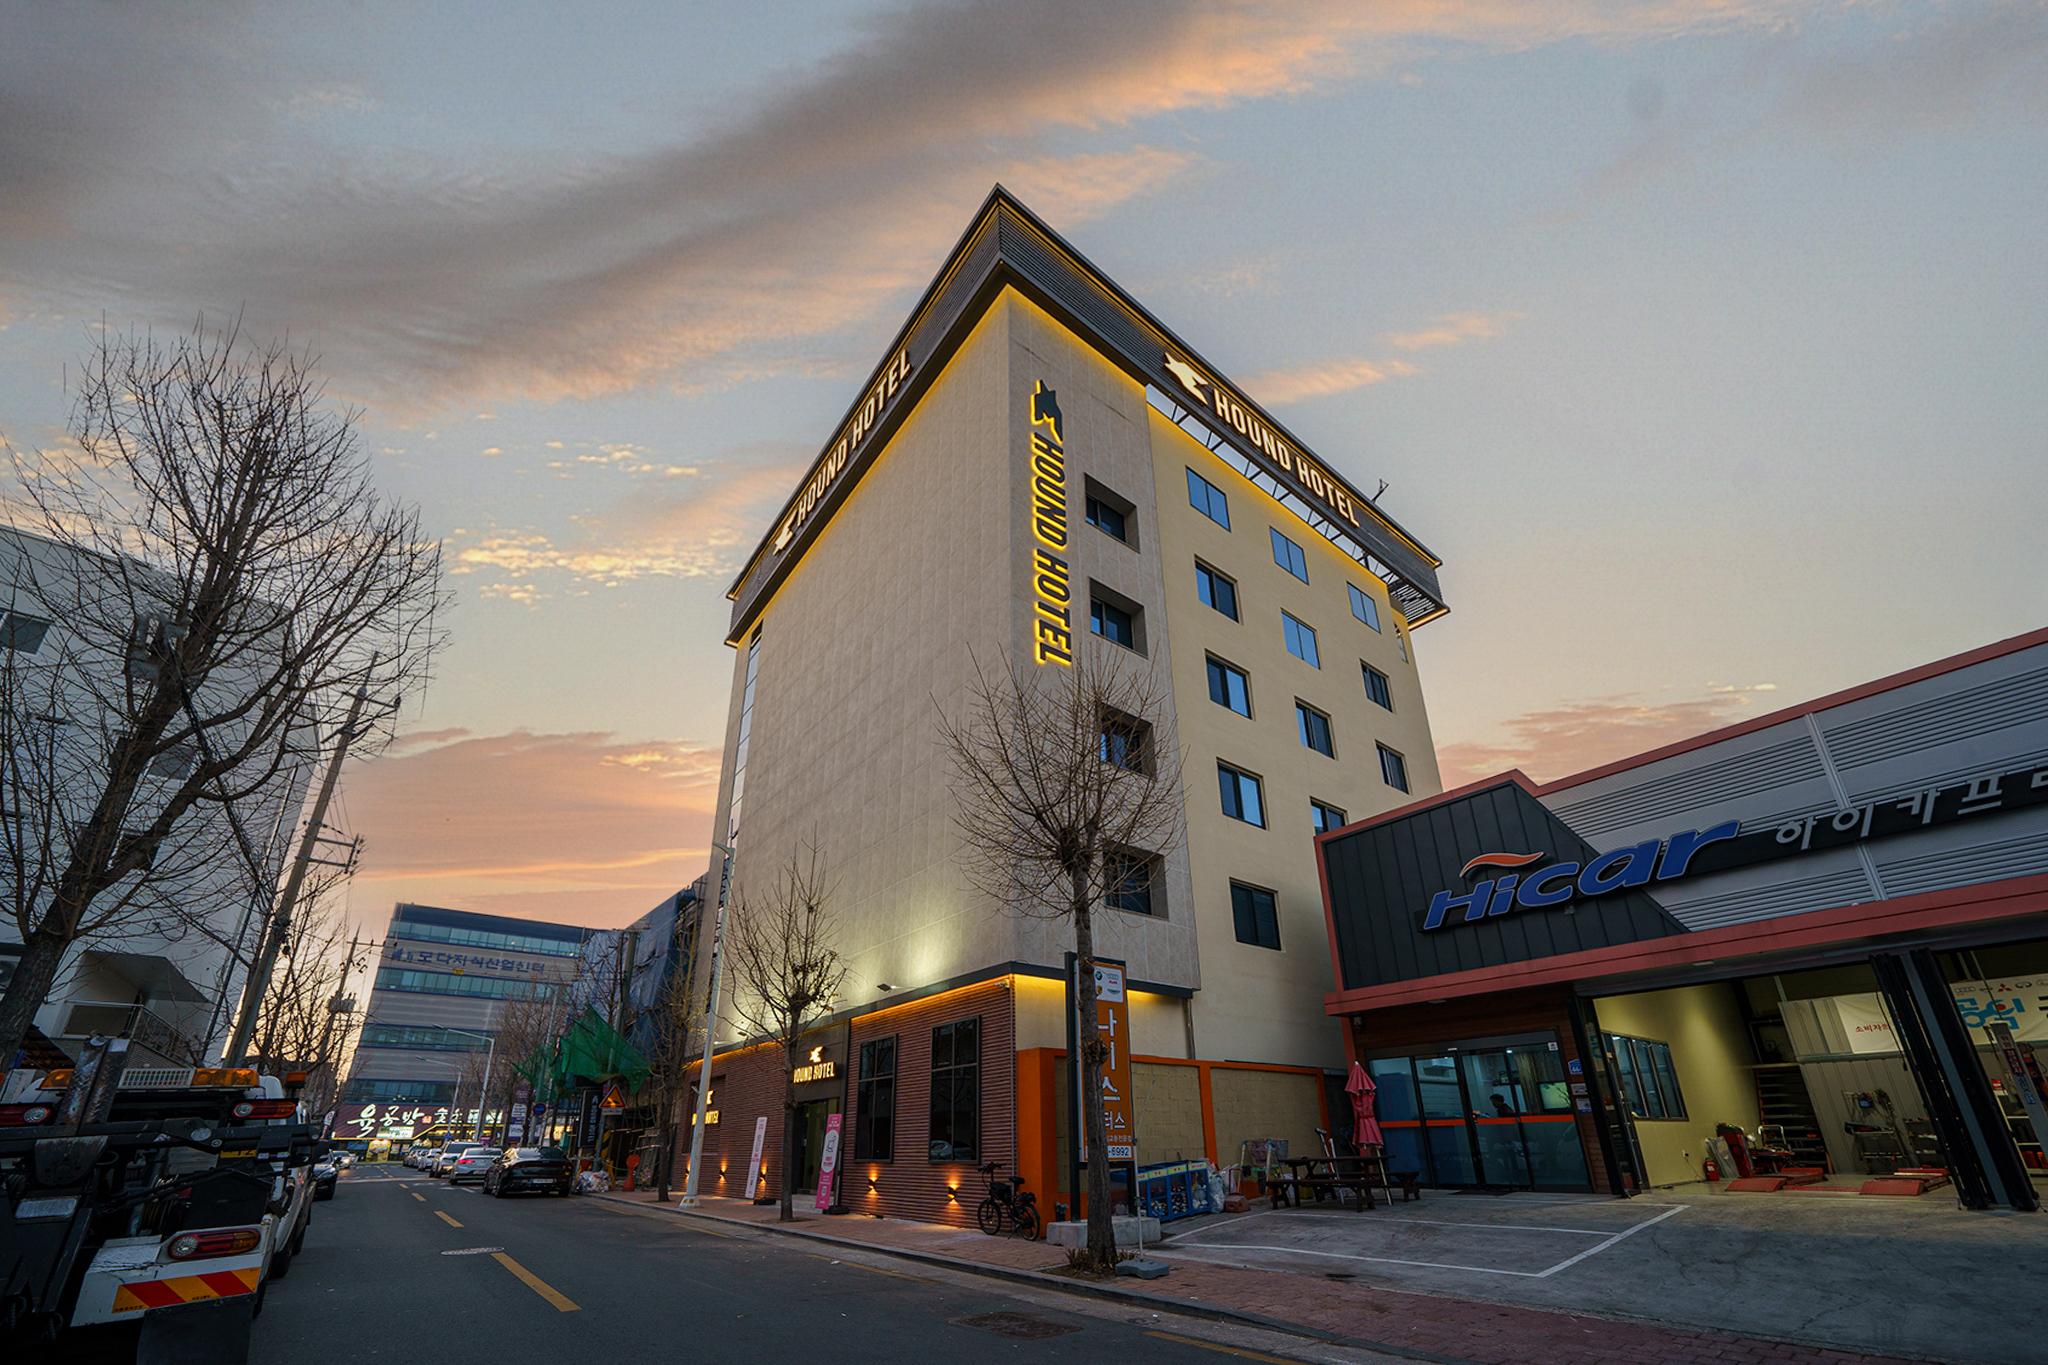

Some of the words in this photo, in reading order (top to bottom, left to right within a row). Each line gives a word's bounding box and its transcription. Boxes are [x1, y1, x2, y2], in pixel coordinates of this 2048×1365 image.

[797, 438, 848, 527] HOUND
[851, 349, 911, 449] HOTEL
[1032, 431, 1068, 549] HOUND
[1213, 388, 1291, 471] HOUND
[1296, 455, 1360, 527] HOTEL
[1034, 549, 1073, 666] HOTEL
[1422, 819, 1741, 932] Hicar
[346, 1103, 425, 1138] 육공방
[813, 1061, 835, 1080] HOTEL
